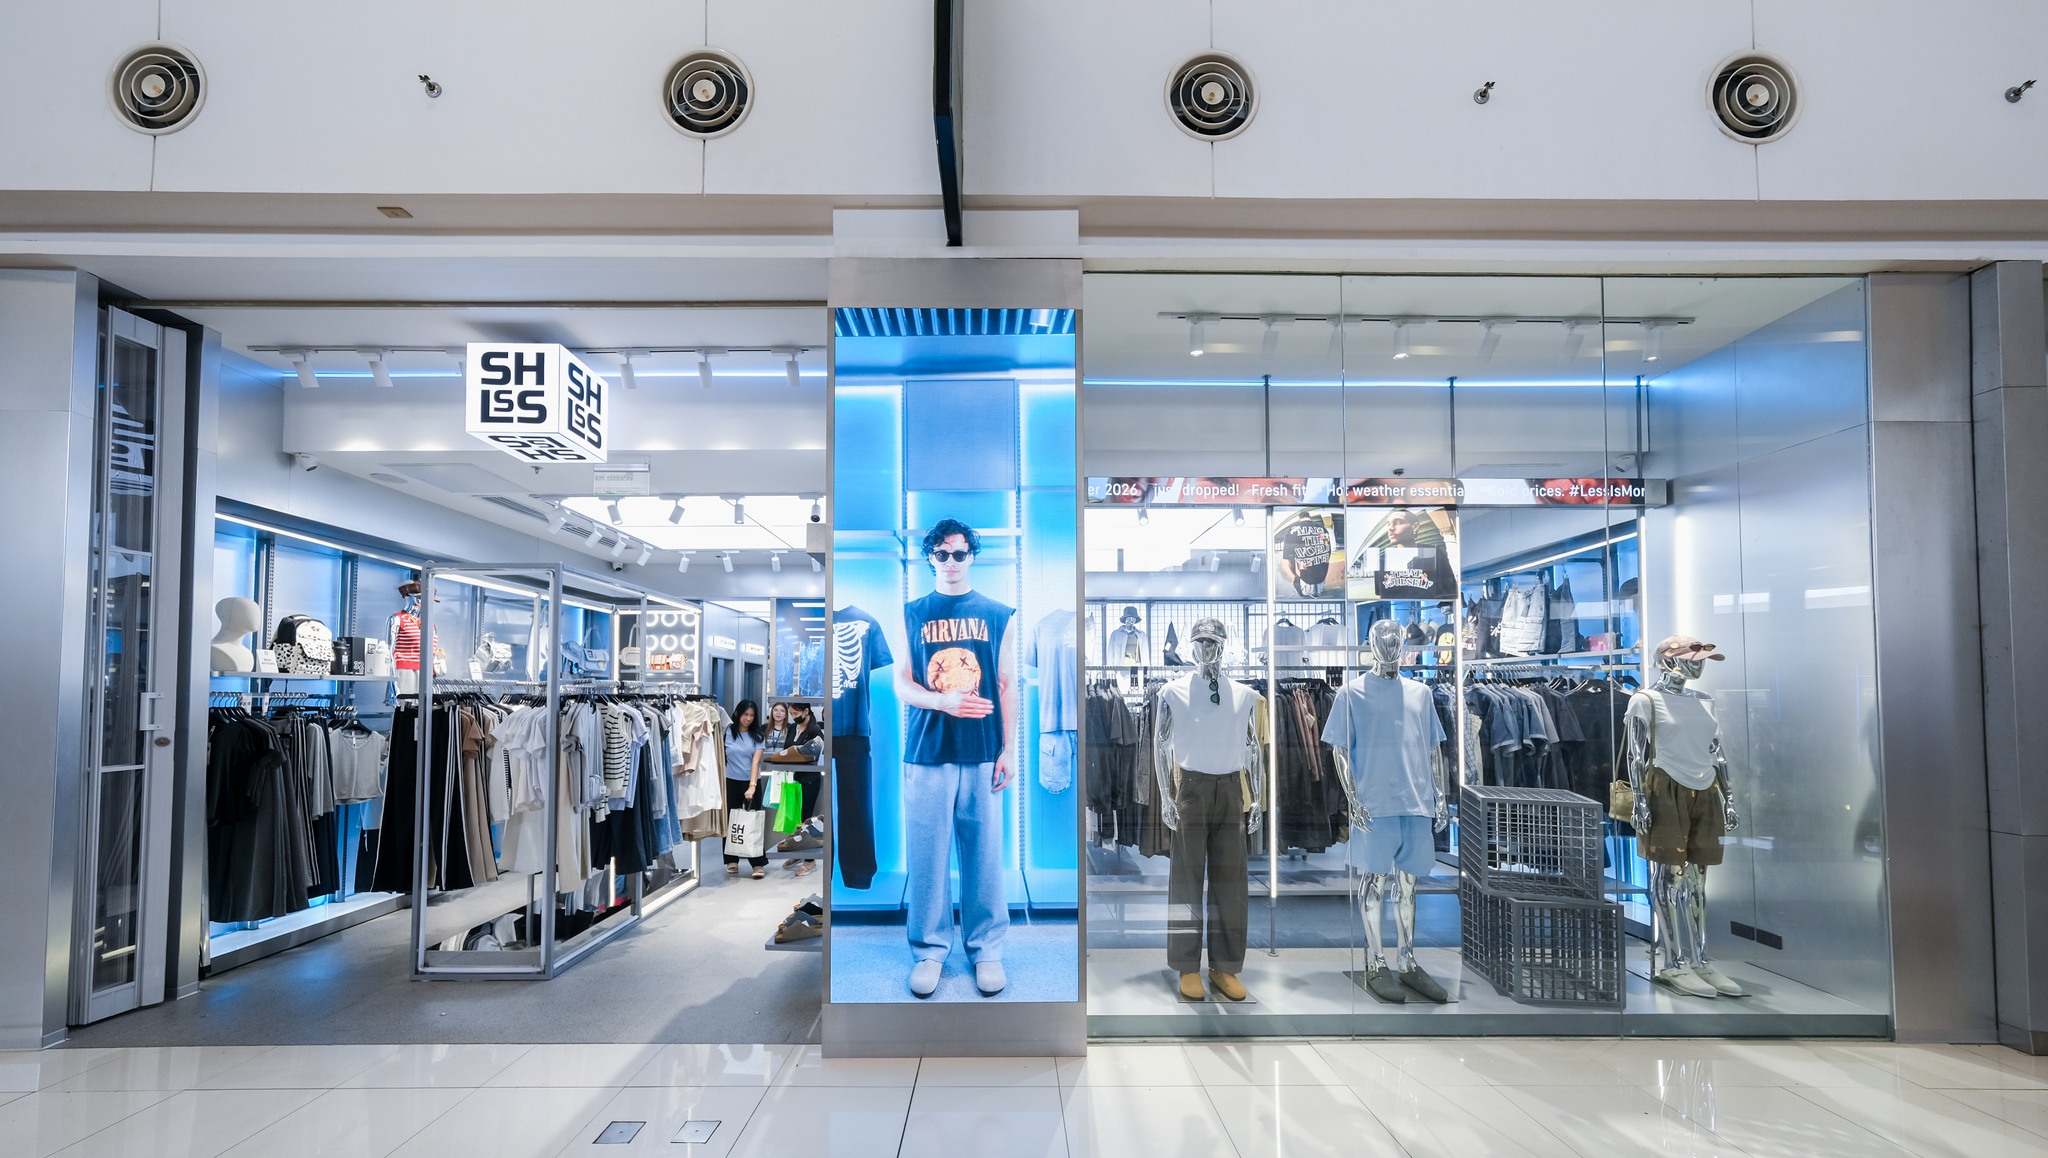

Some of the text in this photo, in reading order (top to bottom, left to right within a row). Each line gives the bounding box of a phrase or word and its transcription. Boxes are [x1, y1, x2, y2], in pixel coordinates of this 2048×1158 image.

[481, 351, 545, 386] SH
[568, 362, 602, 415] SH
[1105, 483, 1139, 497] 2026
[1152, 483, 1173, 499] jus
[1182, 483, 1240, 499] dropped!
[1252, 484, 1288, 497] Fresh
[1291, 484, 1307, 497] fit
[1327, 484, 1349, 497] Hot
[1352, 484, 1406, 497] weather
[1409, 484, 1465, 497] essentia
[921, 618, 989, 644] NIRVANA
[731, 823, 745, 834] SH
